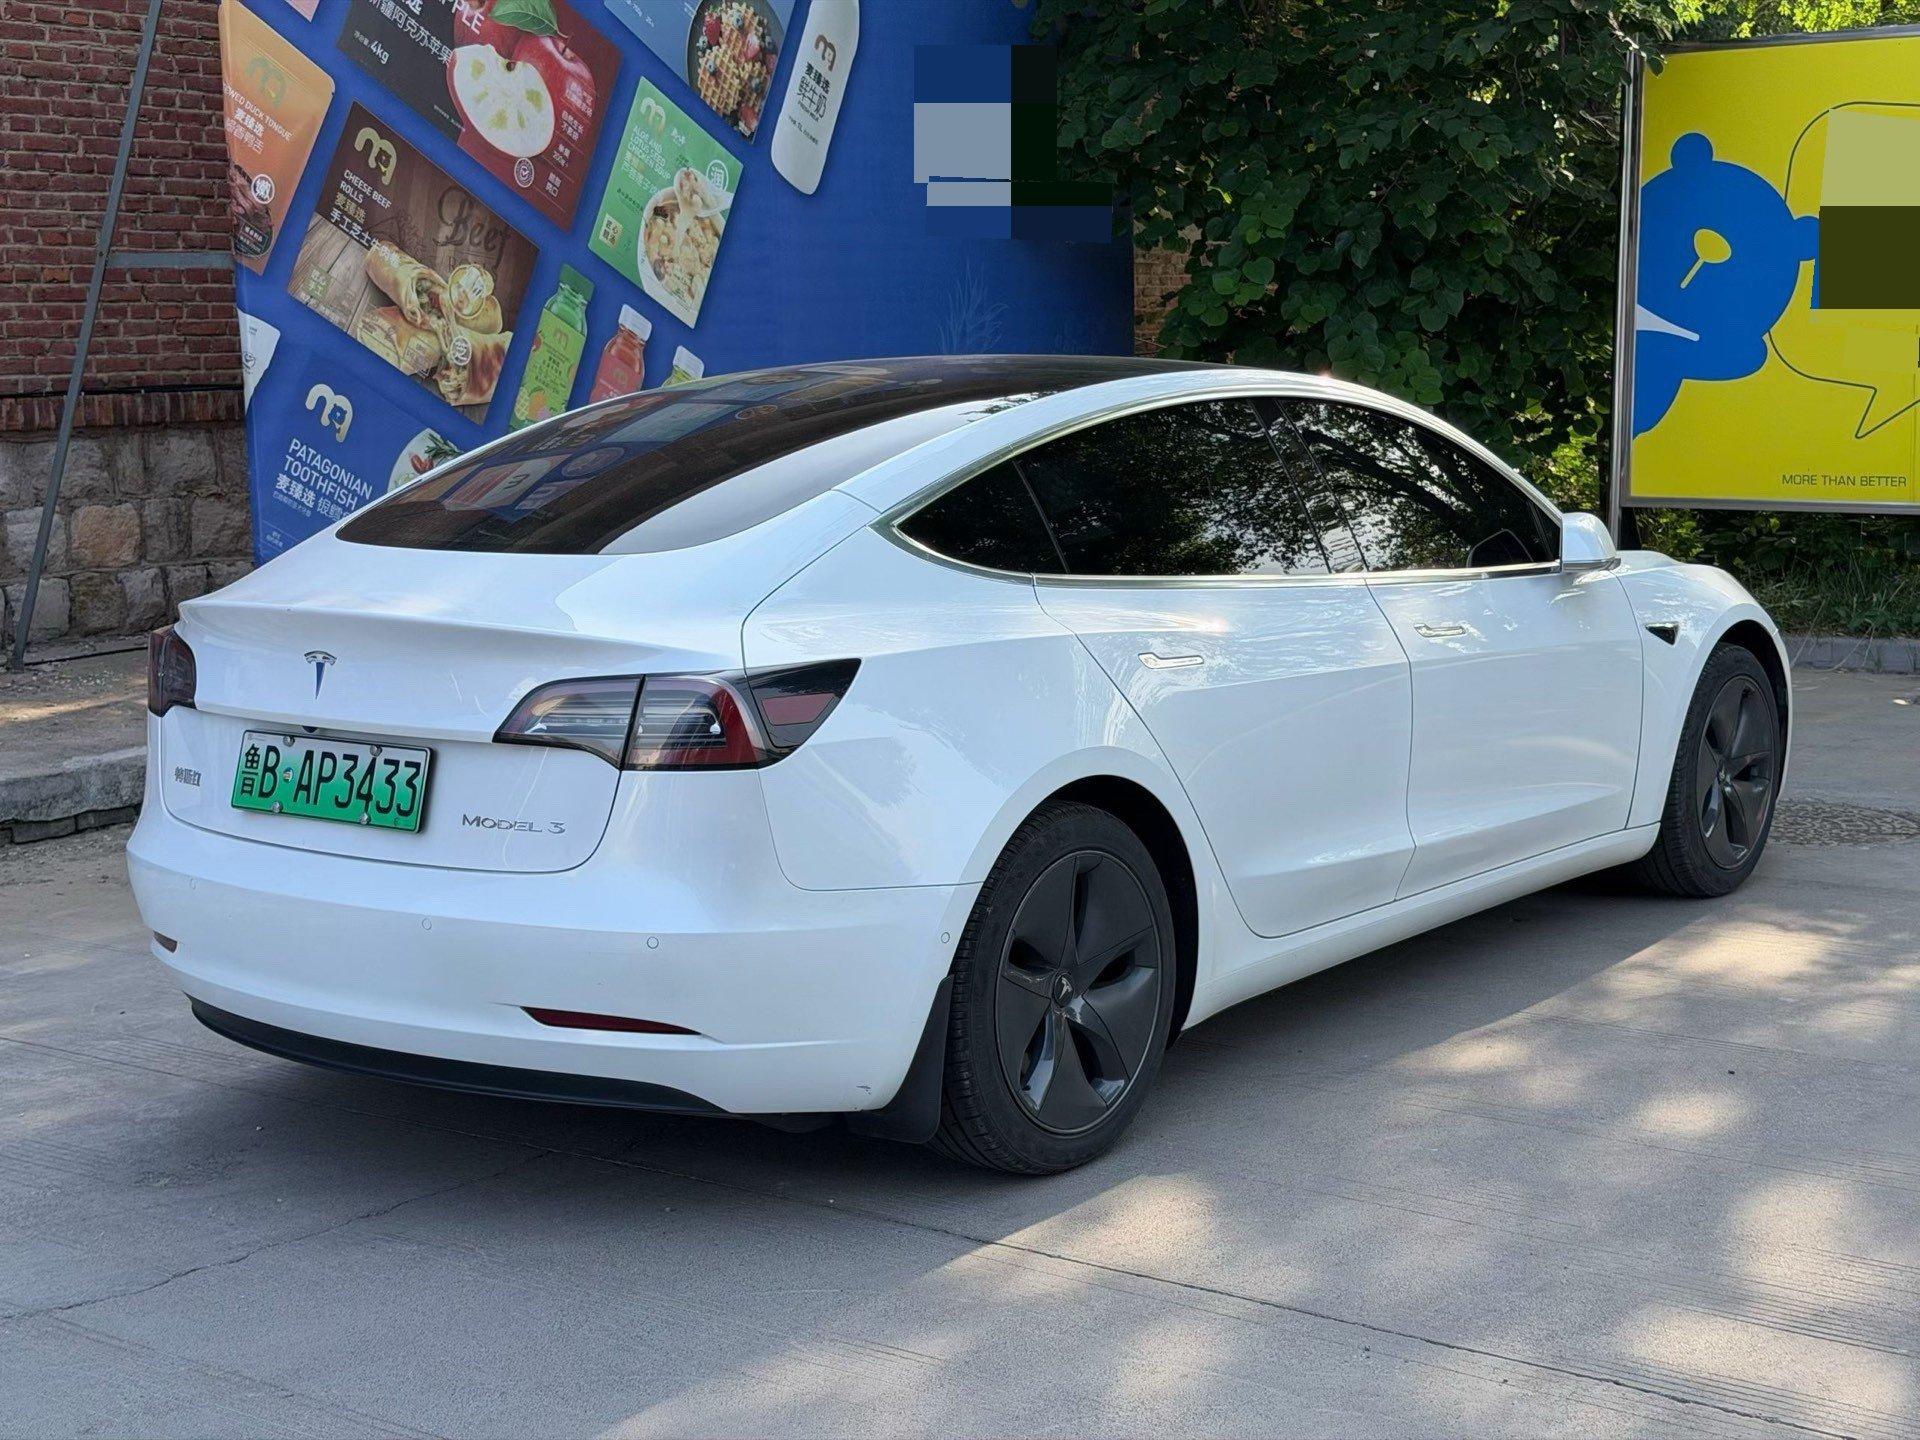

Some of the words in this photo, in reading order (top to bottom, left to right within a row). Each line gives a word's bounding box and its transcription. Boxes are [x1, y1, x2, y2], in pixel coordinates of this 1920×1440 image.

[440, 0, 485, 35] PLE
[370, 40, 390, 65] 4kg
[805, 61, 830, 94] 麦臻选
[244, 101, 264, 120] DUCK
[265, 116, 293, 142] TONGUE
[628, 142, 655, 168] CHICKEN
[654, 164, 672, 180] SOUP
[630, 135, 650, 153] LOTUS
[650, 149, 666, 167] SEED
[340, 181, 364, 204] ROLLS
[343, 169, 373, 197] CHEESE
[372, 190, 393, 210] BEEF
[334, 192, 367, 224] 麦臻选
[284, 454, 358, 511] TOOTHFISH
[288, 438, 373, 500] PATAGONIAN
[1782, 474, 1818, 486] MORE
[1821, 474, 1856, 486] THAN
[1860, 475, 1907, 487] BETTER
[275, 473, 316, 508] 麦臻选
[462, 813, 543, 833] MODEL
[548, 821, 566, 834] 3
